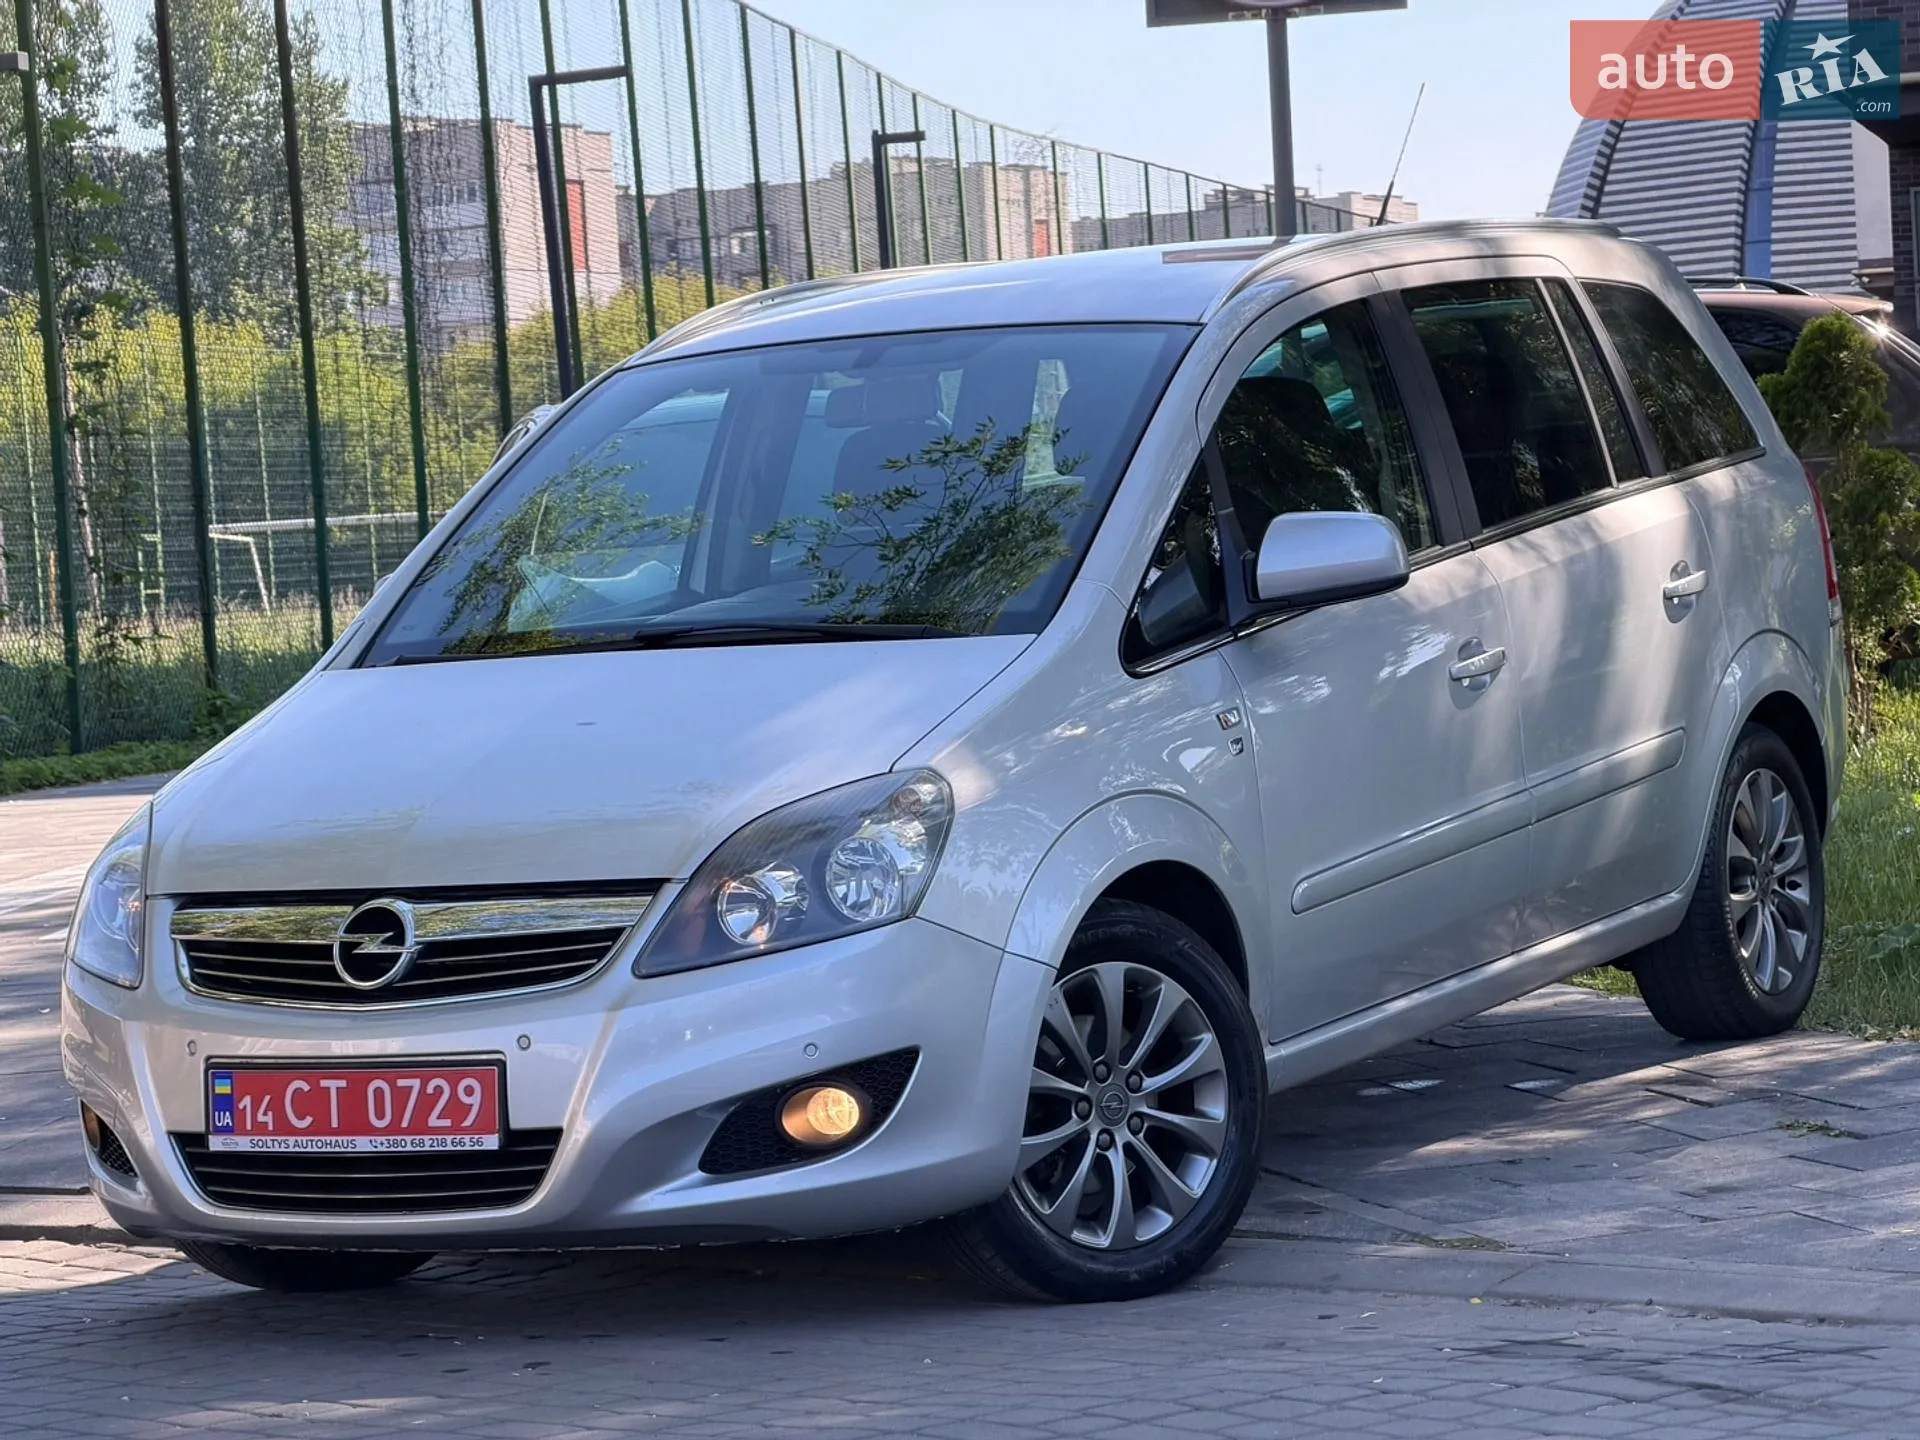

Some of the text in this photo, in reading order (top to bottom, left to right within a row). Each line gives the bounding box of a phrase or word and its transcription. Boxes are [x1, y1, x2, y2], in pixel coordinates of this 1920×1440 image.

[238, 1077, 483, 1131] 14 CT 0729
[214, 1111, 233, 1127] UA
[249, 1138, 290, 1150] SOLTYS
[293, 1138, 358, 1149] AUTOHAUS
[380, 1138, 408, 1149] +380
[410, 1138, 426, 1149] 68
[428, 1137, 448, 1148] 218
[450, 1136, 467, 1148] 66
[468, 1136, 485, 1147] 56
